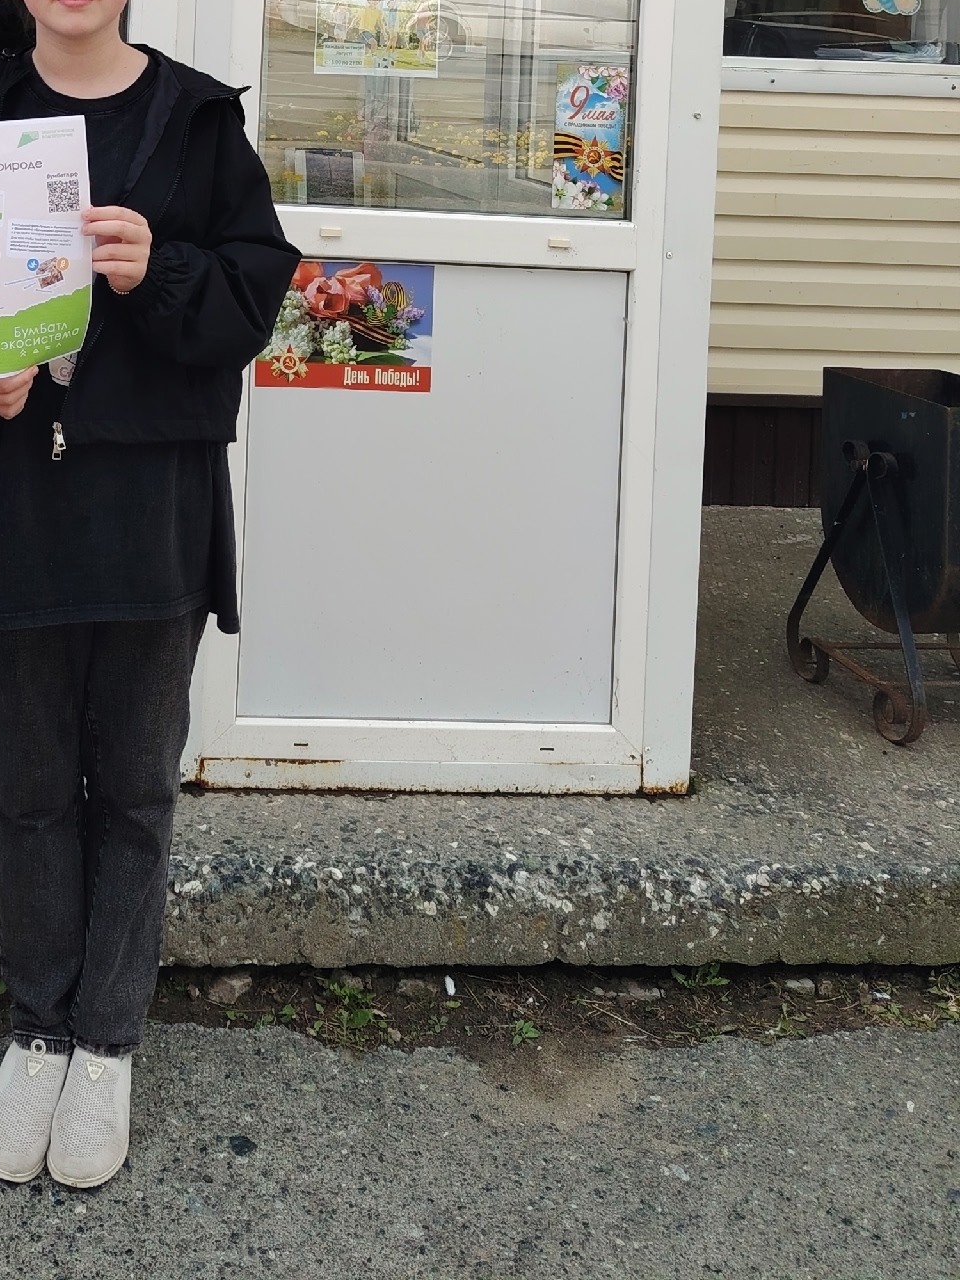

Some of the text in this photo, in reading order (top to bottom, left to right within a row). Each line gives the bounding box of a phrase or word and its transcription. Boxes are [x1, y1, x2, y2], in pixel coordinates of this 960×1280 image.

[568, 85, 616, 121] 9 мая
[0, 327, 80, 351] экосистема
[14, 322, 68, 338] БумБатл
[343, 366, 420, 388] День Победы!
